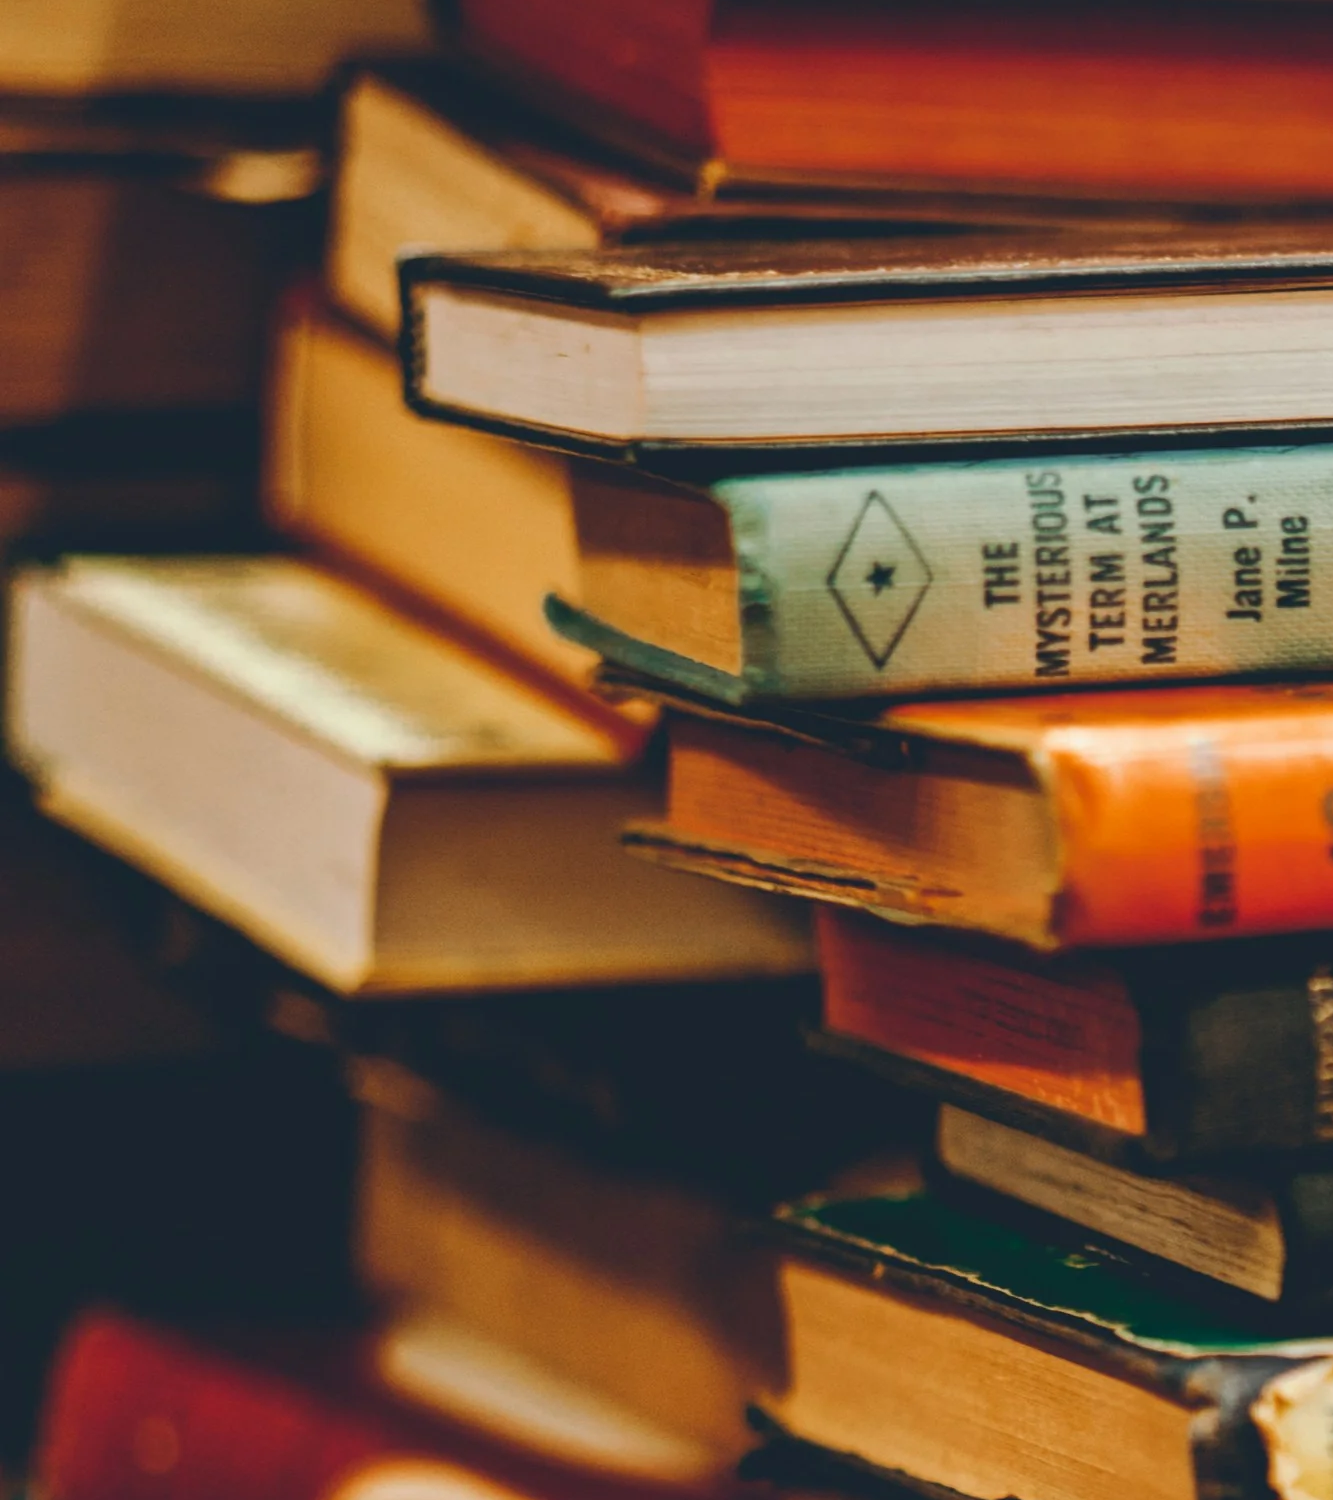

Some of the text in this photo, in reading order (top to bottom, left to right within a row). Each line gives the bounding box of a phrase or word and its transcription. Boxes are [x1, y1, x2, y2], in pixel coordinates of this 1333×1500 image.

[984, 541, 1020, 608] THE
[1026, 471, 1071, 678] MYSTERIOUS
[1087, 493, 1127, 651] TERM AT
[1134, 473, 1178, 665] MERLANDS
[1222, 493, 1262, 623] Jane P.
[1277, 515, 1310, 608] Milne
